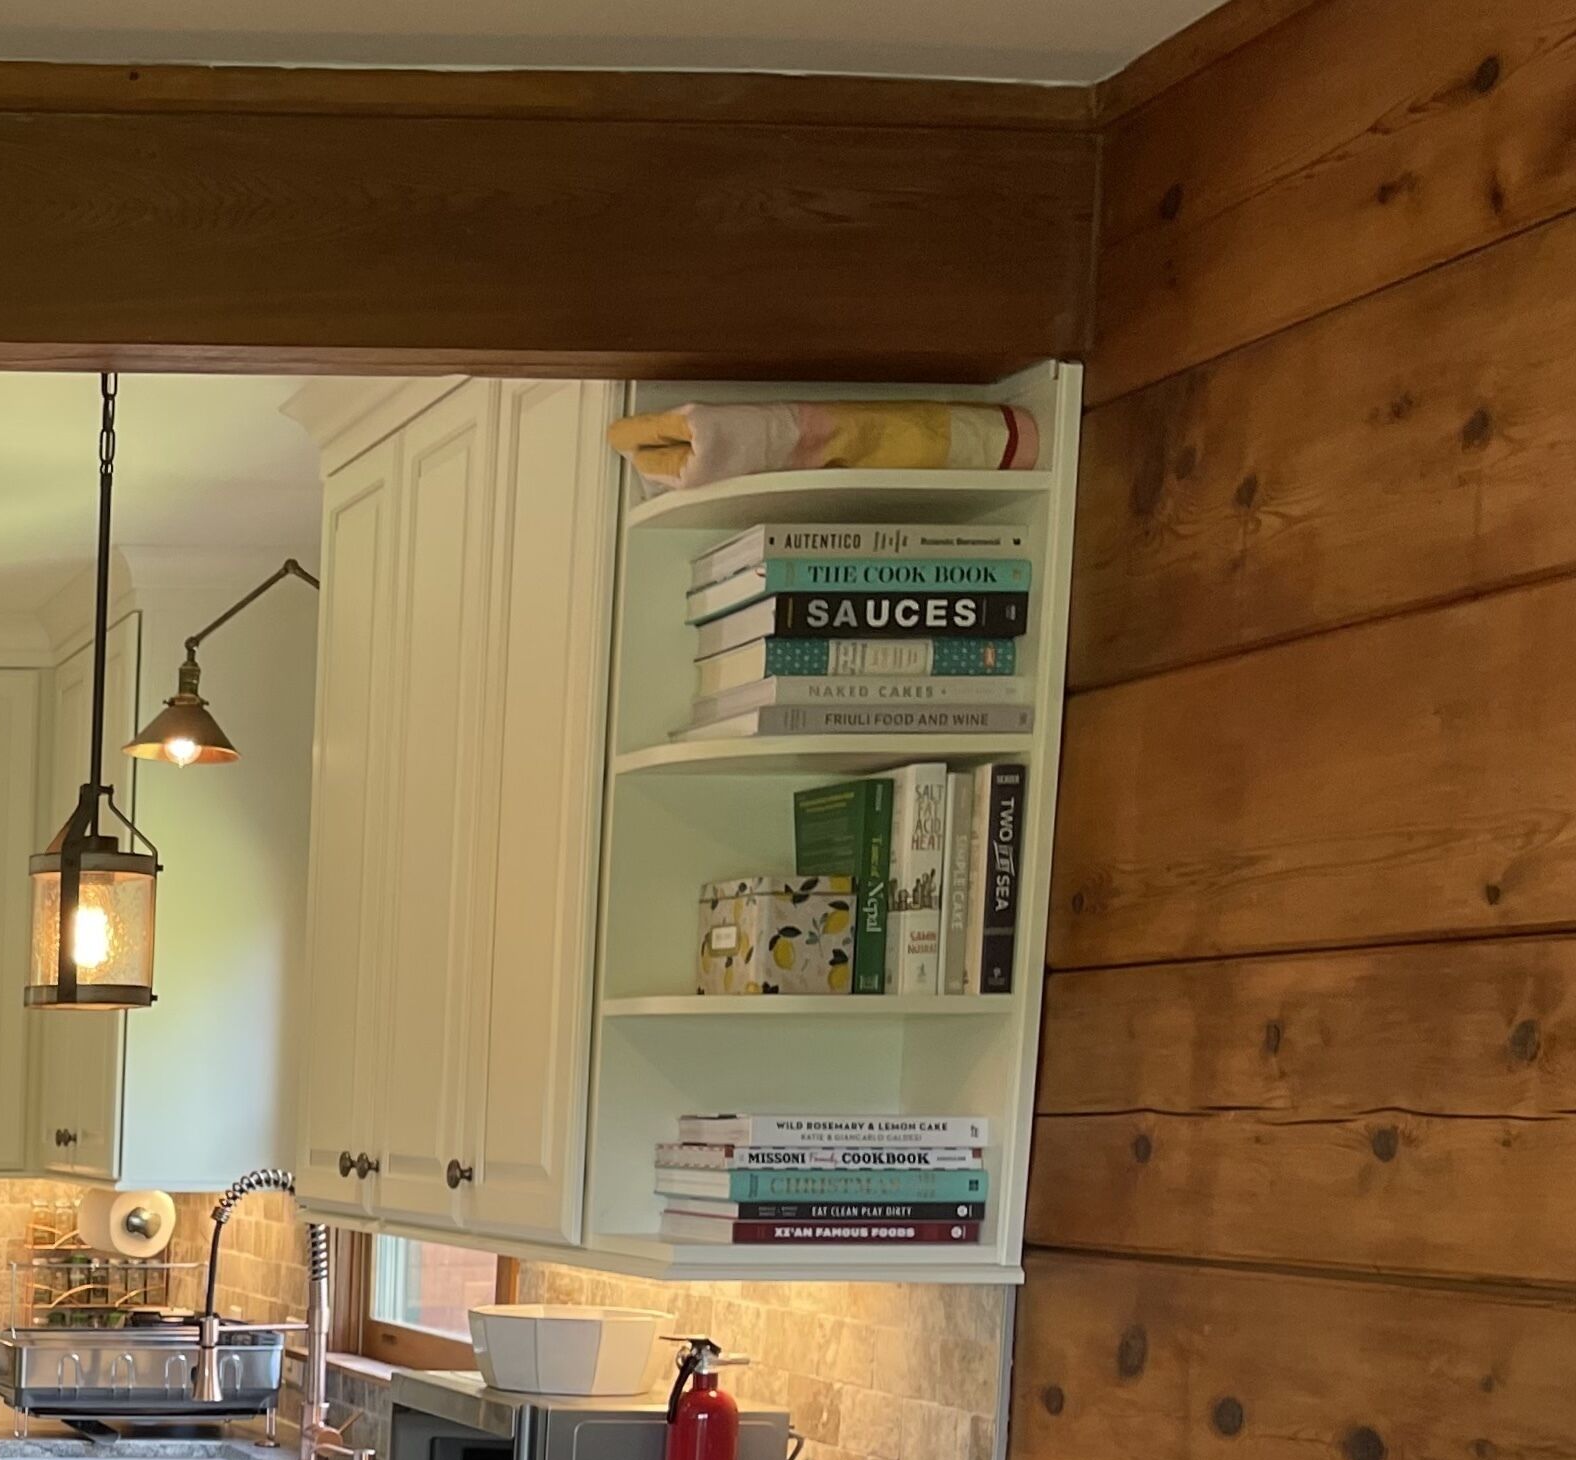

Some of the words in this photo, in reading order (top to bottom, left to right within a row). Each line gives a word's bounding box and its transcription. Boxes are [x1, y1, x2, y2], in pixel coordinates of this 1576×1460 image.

[784, 533, 862, 549] AUTENTICO
[807, 565, 858, 584] THE
[863, 565, 926, 584] COOK
[934, 565, 998, 584] BOOK
[806, 598, 977, 628] SAUCES
[808, 685, 869, 698] NAKED
[878, 685, 934, 698] CAKES
[825, 713, 871, 726] FRIULI
[874, 713, 914, 726] FOOD
[918, 713, 949, 727] AND
[952, 713, 989, 726] WINE
[915, 783, 944, 800] SALT
[914, 818, 941, 834] ACID
[999, 796, 1015, 842] TWO
[911, 833, 943, 850] HEAT
[995, 873, 1011, 912] SEA
[776, 1121, 804, 1131] WILD
[806, 1121, 865, 1131] ROSEMARY
[868, 1121, 875, 1131] &
[878, 1121, 916, 1131] LEMON
[919, 1121, 948, 1131] CAKE
[748, 1152, 806, 1165] MISSONI
[842, 1152, 931, 1165] COOKBOOK
[811, 1205, 829, 1217] EAT
[830, 1205, 859, 1217] CLEAN
[861, 1205, 884, 1217] PLAY
[886, 1205, 913, 1217] DIRTY
[815, 1226, 869, 1238] FAMOUS
[871, 1226, 916, 1238] FOODS
